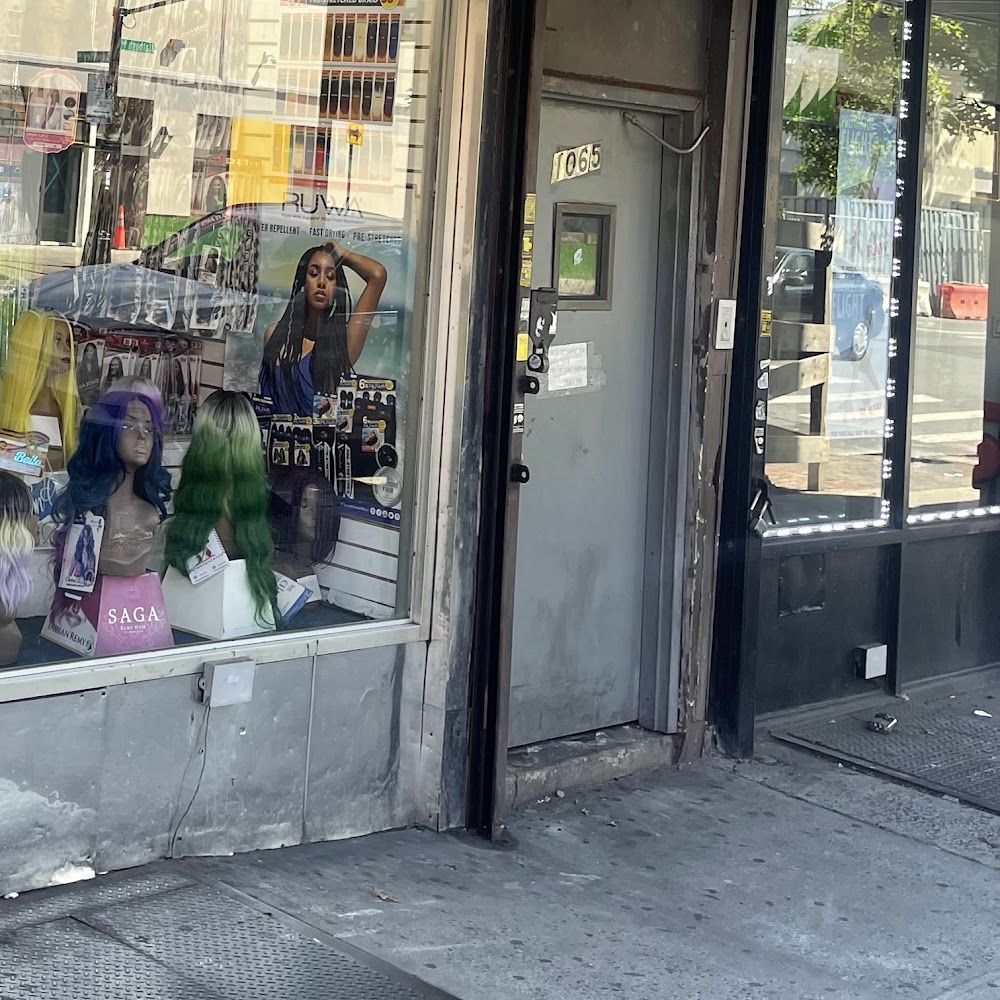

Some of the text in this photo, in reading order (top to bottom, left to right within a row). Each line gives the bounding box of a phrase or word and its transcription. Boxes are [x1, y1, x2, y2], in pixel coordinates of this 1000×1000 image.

[556, 144, 601, 181] 1065
[269, 224, 300, 236] REPELLENT
[309, 228, 323, 237] FAST
[108, 606, 160, 625] SAGA
